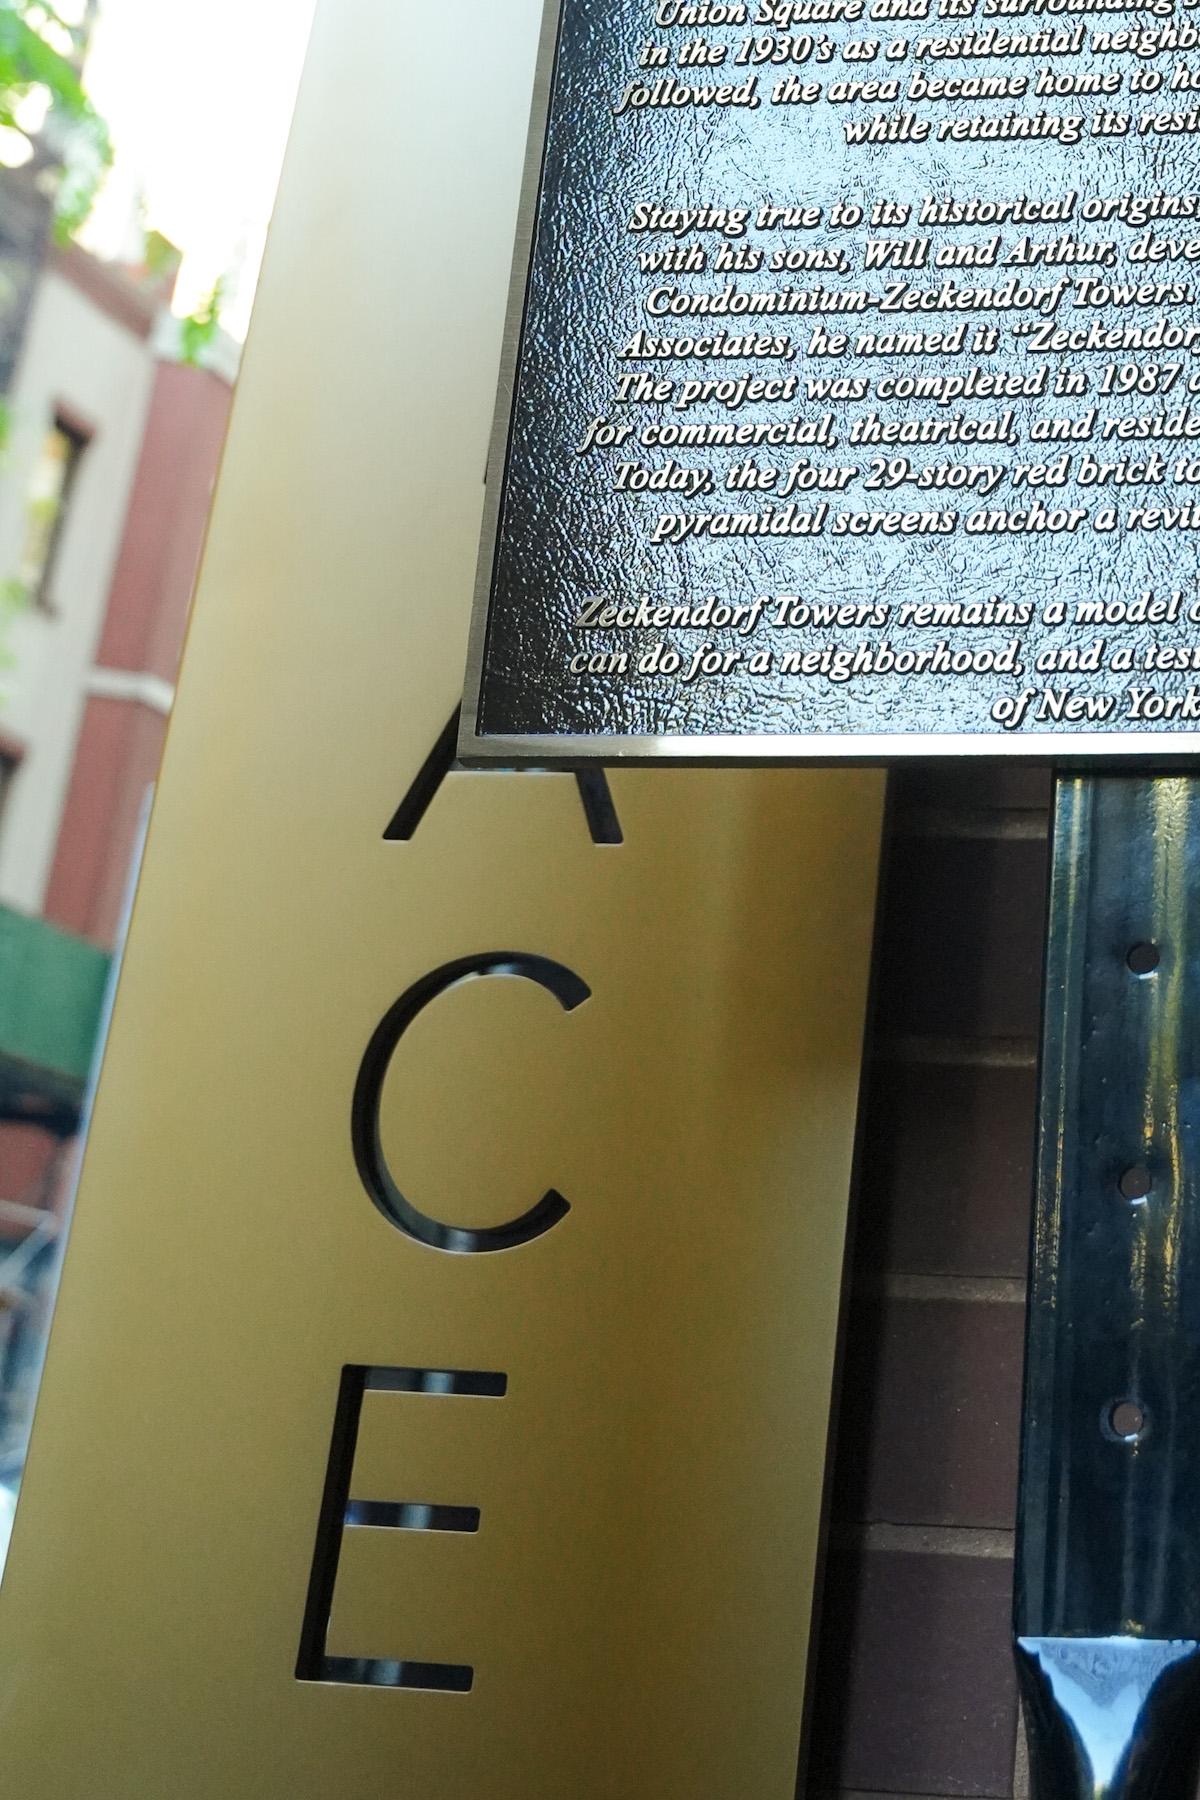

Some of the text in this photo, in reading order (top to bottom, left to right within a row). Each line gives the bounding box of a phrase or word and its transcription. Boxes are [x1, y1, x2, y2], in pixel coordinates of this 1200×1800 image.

[655, 0, 746, 26] Union
[639, 42, 669, 67] in
[678, 38, 726, 64] the
[843, 41, 876, 60] as
[887, 37, 908, 58] a
[914, 25, 1085, 58] residential
[613, 77, 762, 113] followed,
[772, 76, 819, 102] the
[828, 79, 901, 101] area
[908, 72, 1027, 99] became
[1035, 68, 1121, 95] home
[1130, 68, 1163, 92] to
[844, 114, 929, 143] while
[936, 110, 1083, 142] retaining
[1092, 109, 1130, 136] its
[629, 202, 748, 236] Staying
[756, 204, 822, 230] true
[830, 203, 864, 229] to
[871, 199, 911, 226] its
[918, 191, 1078, 225] historical
[638, 243, 707, 272] with
[714, 242, 763, 271] his
[770, 247, 851, 272] sons,
[864, 239, 930, 269] Will
[935, 237, 998, 266] and
[1004, 236, 1117, 265] Arthur,
[646, 277, 1068, 315] Condominium-Zeckendorf
[1073, 278, 1195, 306] Towers.
[617, 330, 796, 361] Associates,
[808, 325, 848, 356] he
[855, 325, 965, 355] named
[972, 328, 1000, 354] it
[617, 373, 672, 401] The
[677, 373, 798, 410] project
[807, 377, 869, 399] was
[877, 366, 1049, 403] completed
[1055, 367, 1088, 395] in
[1100, 364, 1183, 395] 1987
[577, 416, 633, 454] for
[642, 414, 839, 447] commercial,
[850, 412, 1020, 444] theatrical,
[1031, 410, 1097, 440] and
[613, 462, 715, 496] Today,
[726, 460, 777, 490] the
[779, 459, 858, 494] four
[864, 457, 1003, 494] 29-story
[1013, 454, 1068, 485] red
[1077, 452, 1164, 485] brick
[651, 504, 825, 542] pyramidal
[833, 509, 957, 535] screens
[966, 501, 1086, 534] anchor
[1095, 509, 1117, 530] a
[575, 596, 771, 632] Zeckendorf
[772, 596, 890, 628] Towers
[898, 599, 1032, 628] remains
[1042, 604, 1066, 625] a
[1075, 592, 1180, 624] model
[570, 650, 629, 675] can
[638, 644, 681, 674] do
[681, 643, 742, 681] for
[749, 653, 772, 674] a
[780, 641, 1025, 681] neighborhood,
[1036, 641, 1104, 673] and
[1112, 649, 1135, 672] a
[991, 689, 1036, 727] of
[1036, 689, 1115, 721] New
